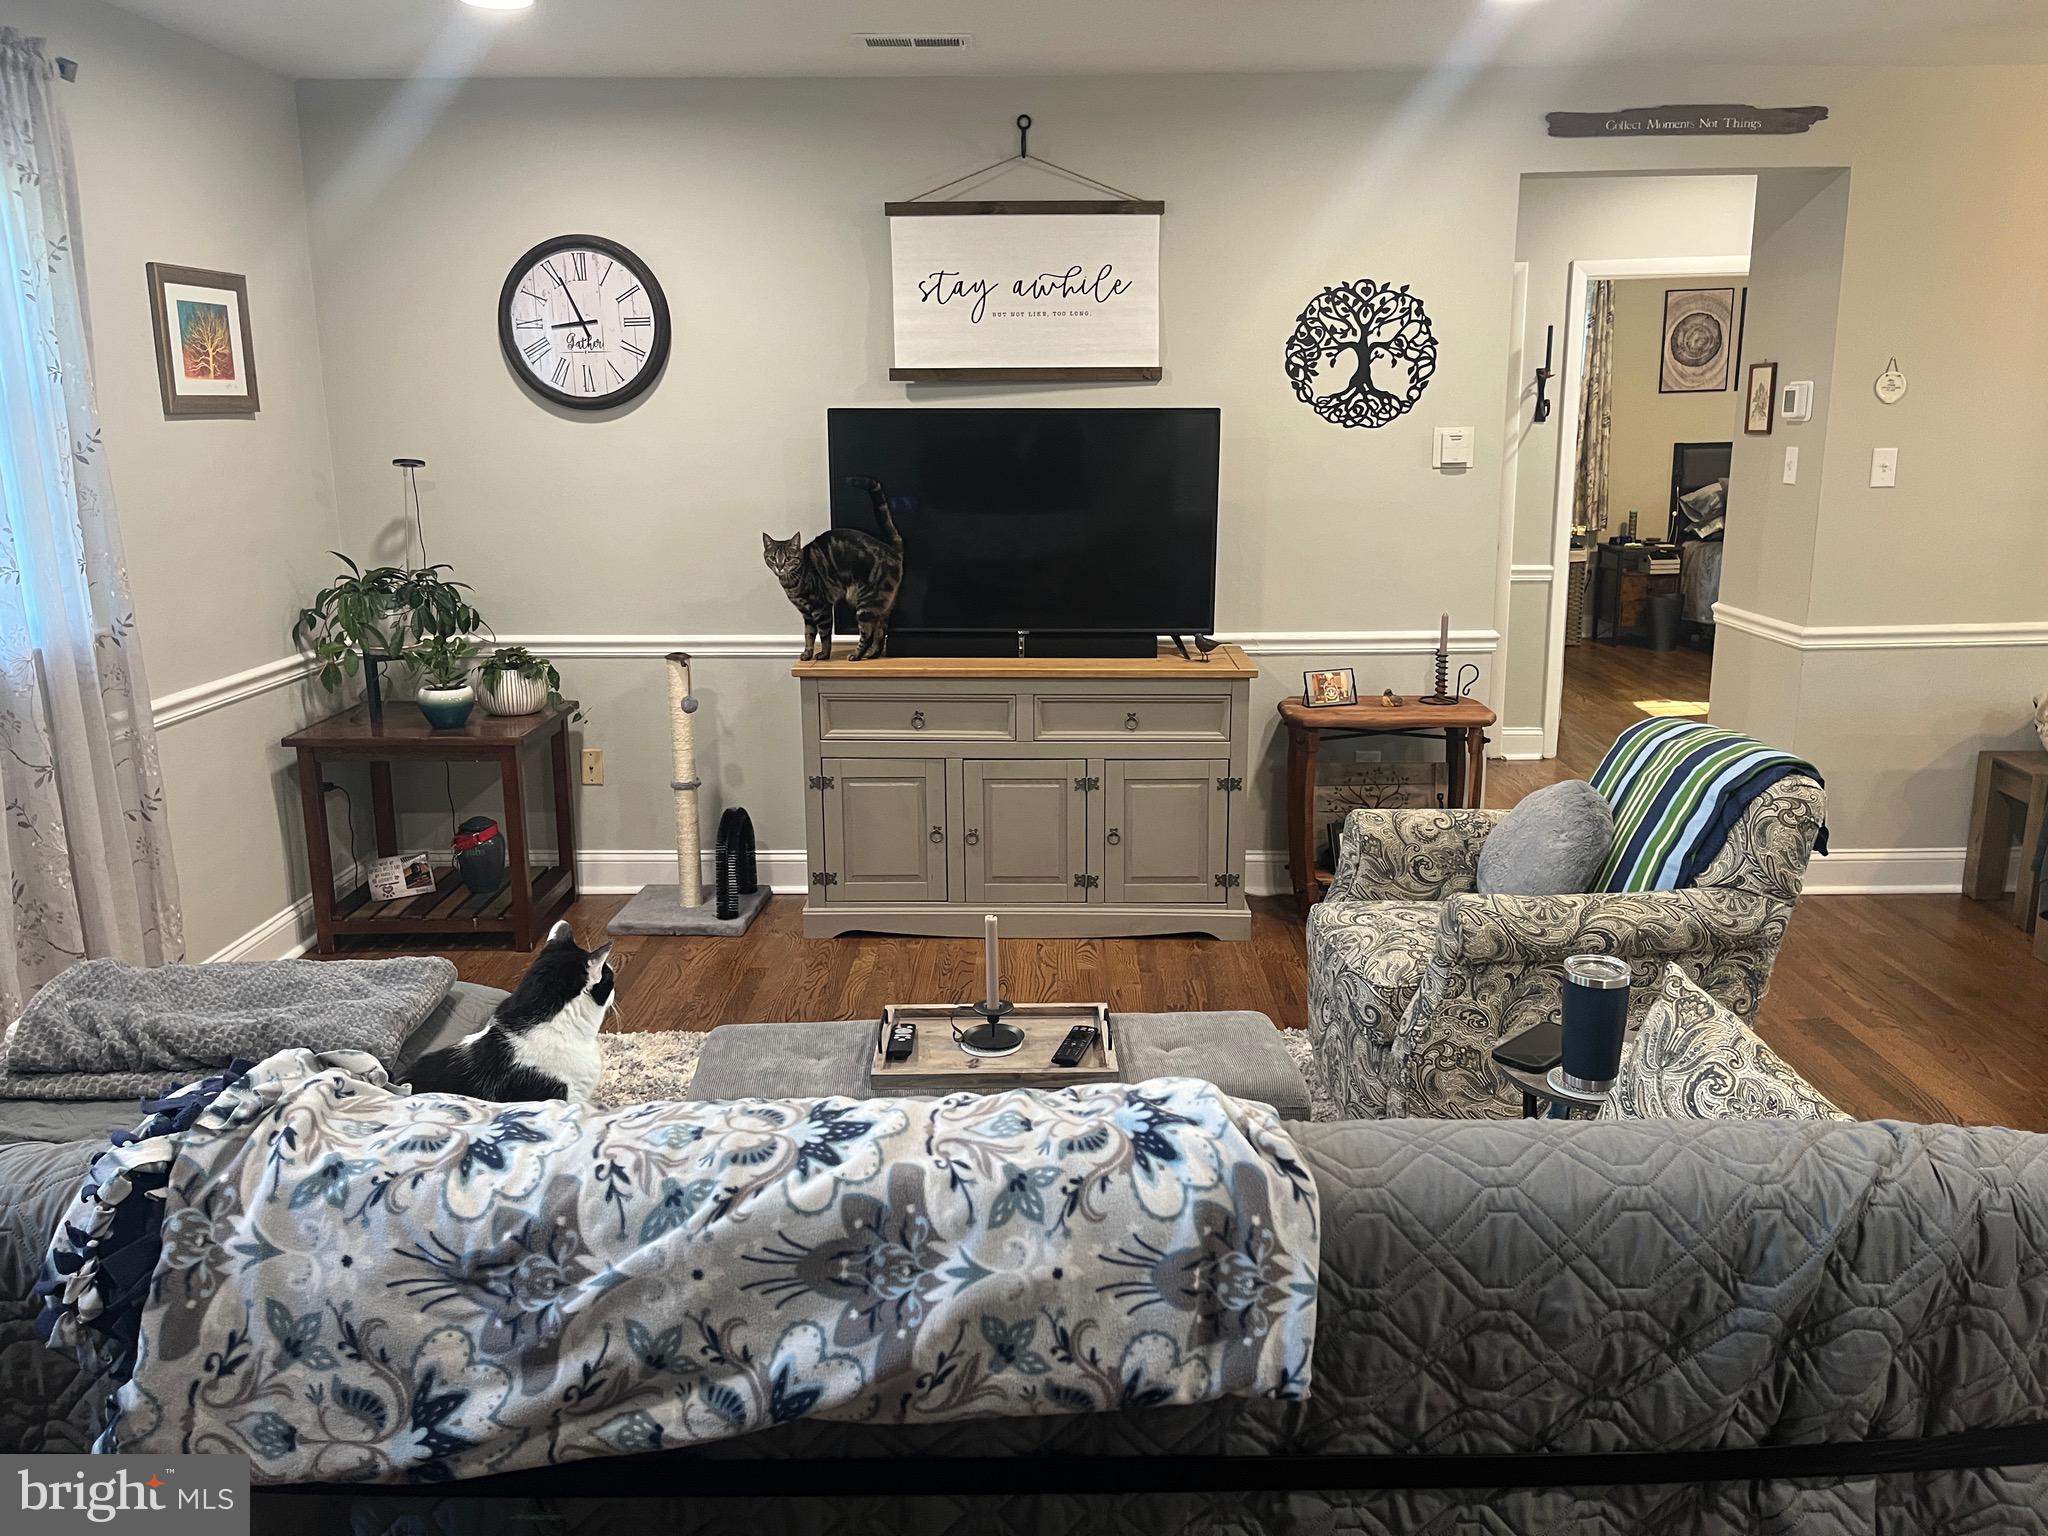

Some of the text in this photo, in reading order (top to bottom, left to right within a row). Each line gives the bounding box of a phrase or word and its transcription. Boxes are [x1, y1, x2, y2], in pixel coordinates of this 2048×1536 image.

[1605, 117, 1762, 131] Collect Moments Not Things
[570, 252, 588, 282] XII
[918, 263, 1134, 325] stay awhile
[565, 332, 605, 351] Gather
